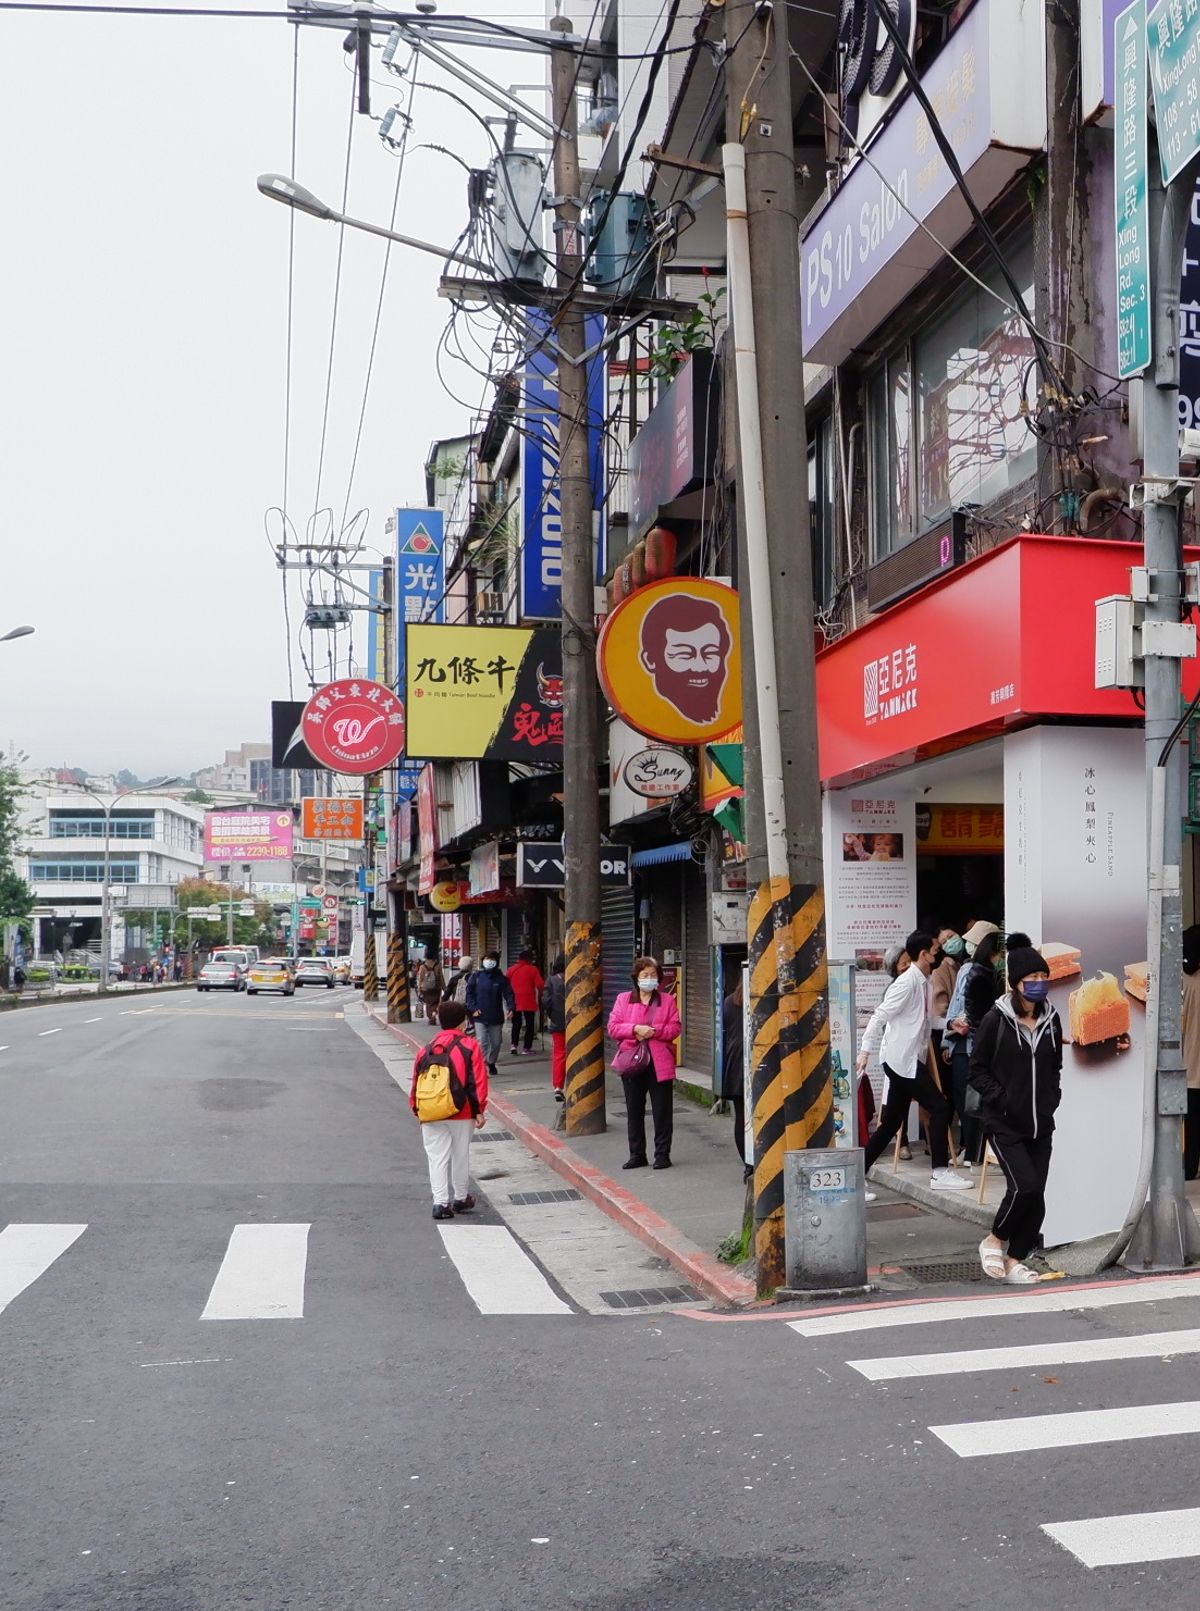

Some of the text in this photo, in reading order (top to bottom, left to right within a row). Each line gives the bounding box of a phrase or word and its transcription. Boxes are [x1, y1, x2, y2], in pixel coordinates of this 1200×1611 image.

[1163, 102, 1178, 132] 108
[1186, 78, 1198, 103] 58
[1123, 39, 1138, 219] 興隆路三段
[1167, 133, 1181, 160] 113
[1190, 108, 1200, 136] 61
[806, 168, 909, 327] PS 10 Salon
[1118, 226, 1137, 249] Xing
[1119, 247, 1140, 269] Long
[1119, 274, 1134, 295] Rd.
[1119, 284, 1145, 314] Sec. 3
[414, 655, 516, 696] 九條牛
[879, 642, 918, 696] 亞尼克
[634, 764, 686, 782] Sunny
[864, 800, 896, 809] 亞尼克
[1084, 767, 1097, 864] 冰心鳳梨夾心
[812, 1171, 842, 1188] 323
